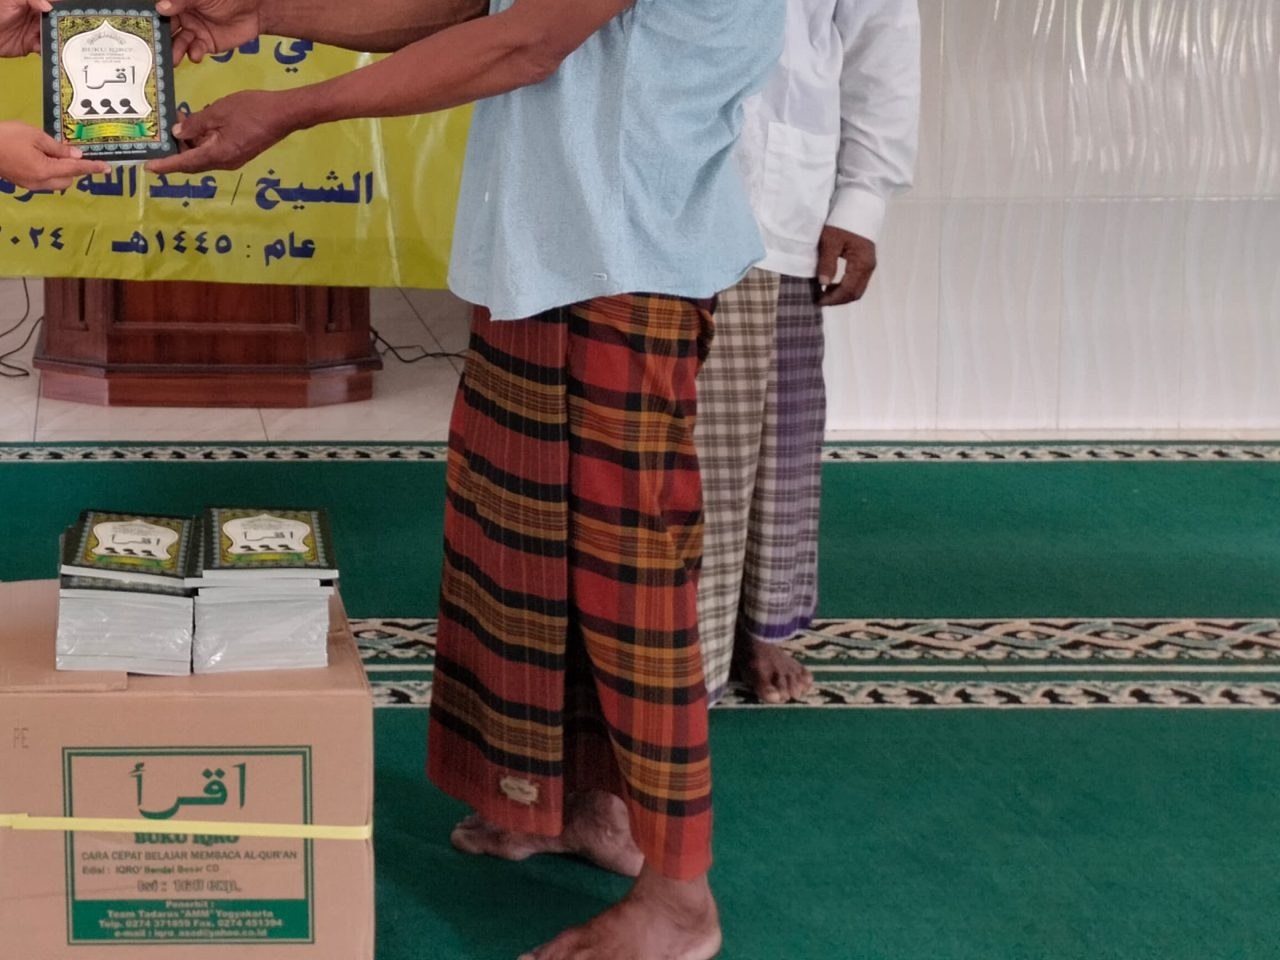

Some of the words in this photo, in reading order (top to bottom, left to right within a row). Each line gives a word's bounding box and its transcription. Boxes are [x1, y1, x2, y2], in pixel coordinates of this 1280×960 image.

[76, 163, 138, 198] الله
[149, 171, 217, 208] عبد
[230, 172, 243, 206] /
[255, 168, 374, 210] الشيخ
[85, 228, 96, 257] /
[264, 231, 316, 266] عام
[128, 762, 247, 820] اقرأ
[81, 851, 109, 860] CARA
[111, 851, 142, 860] CEPAT
[144, 850, 188, 860] BELAJAR
[190, 850, 241, 860] MEMBACA
[106, 910, 136, 918] Team
[137, 910, 179, 918] Tadarus
[215, 909, 275, 919] Yogyakarta
